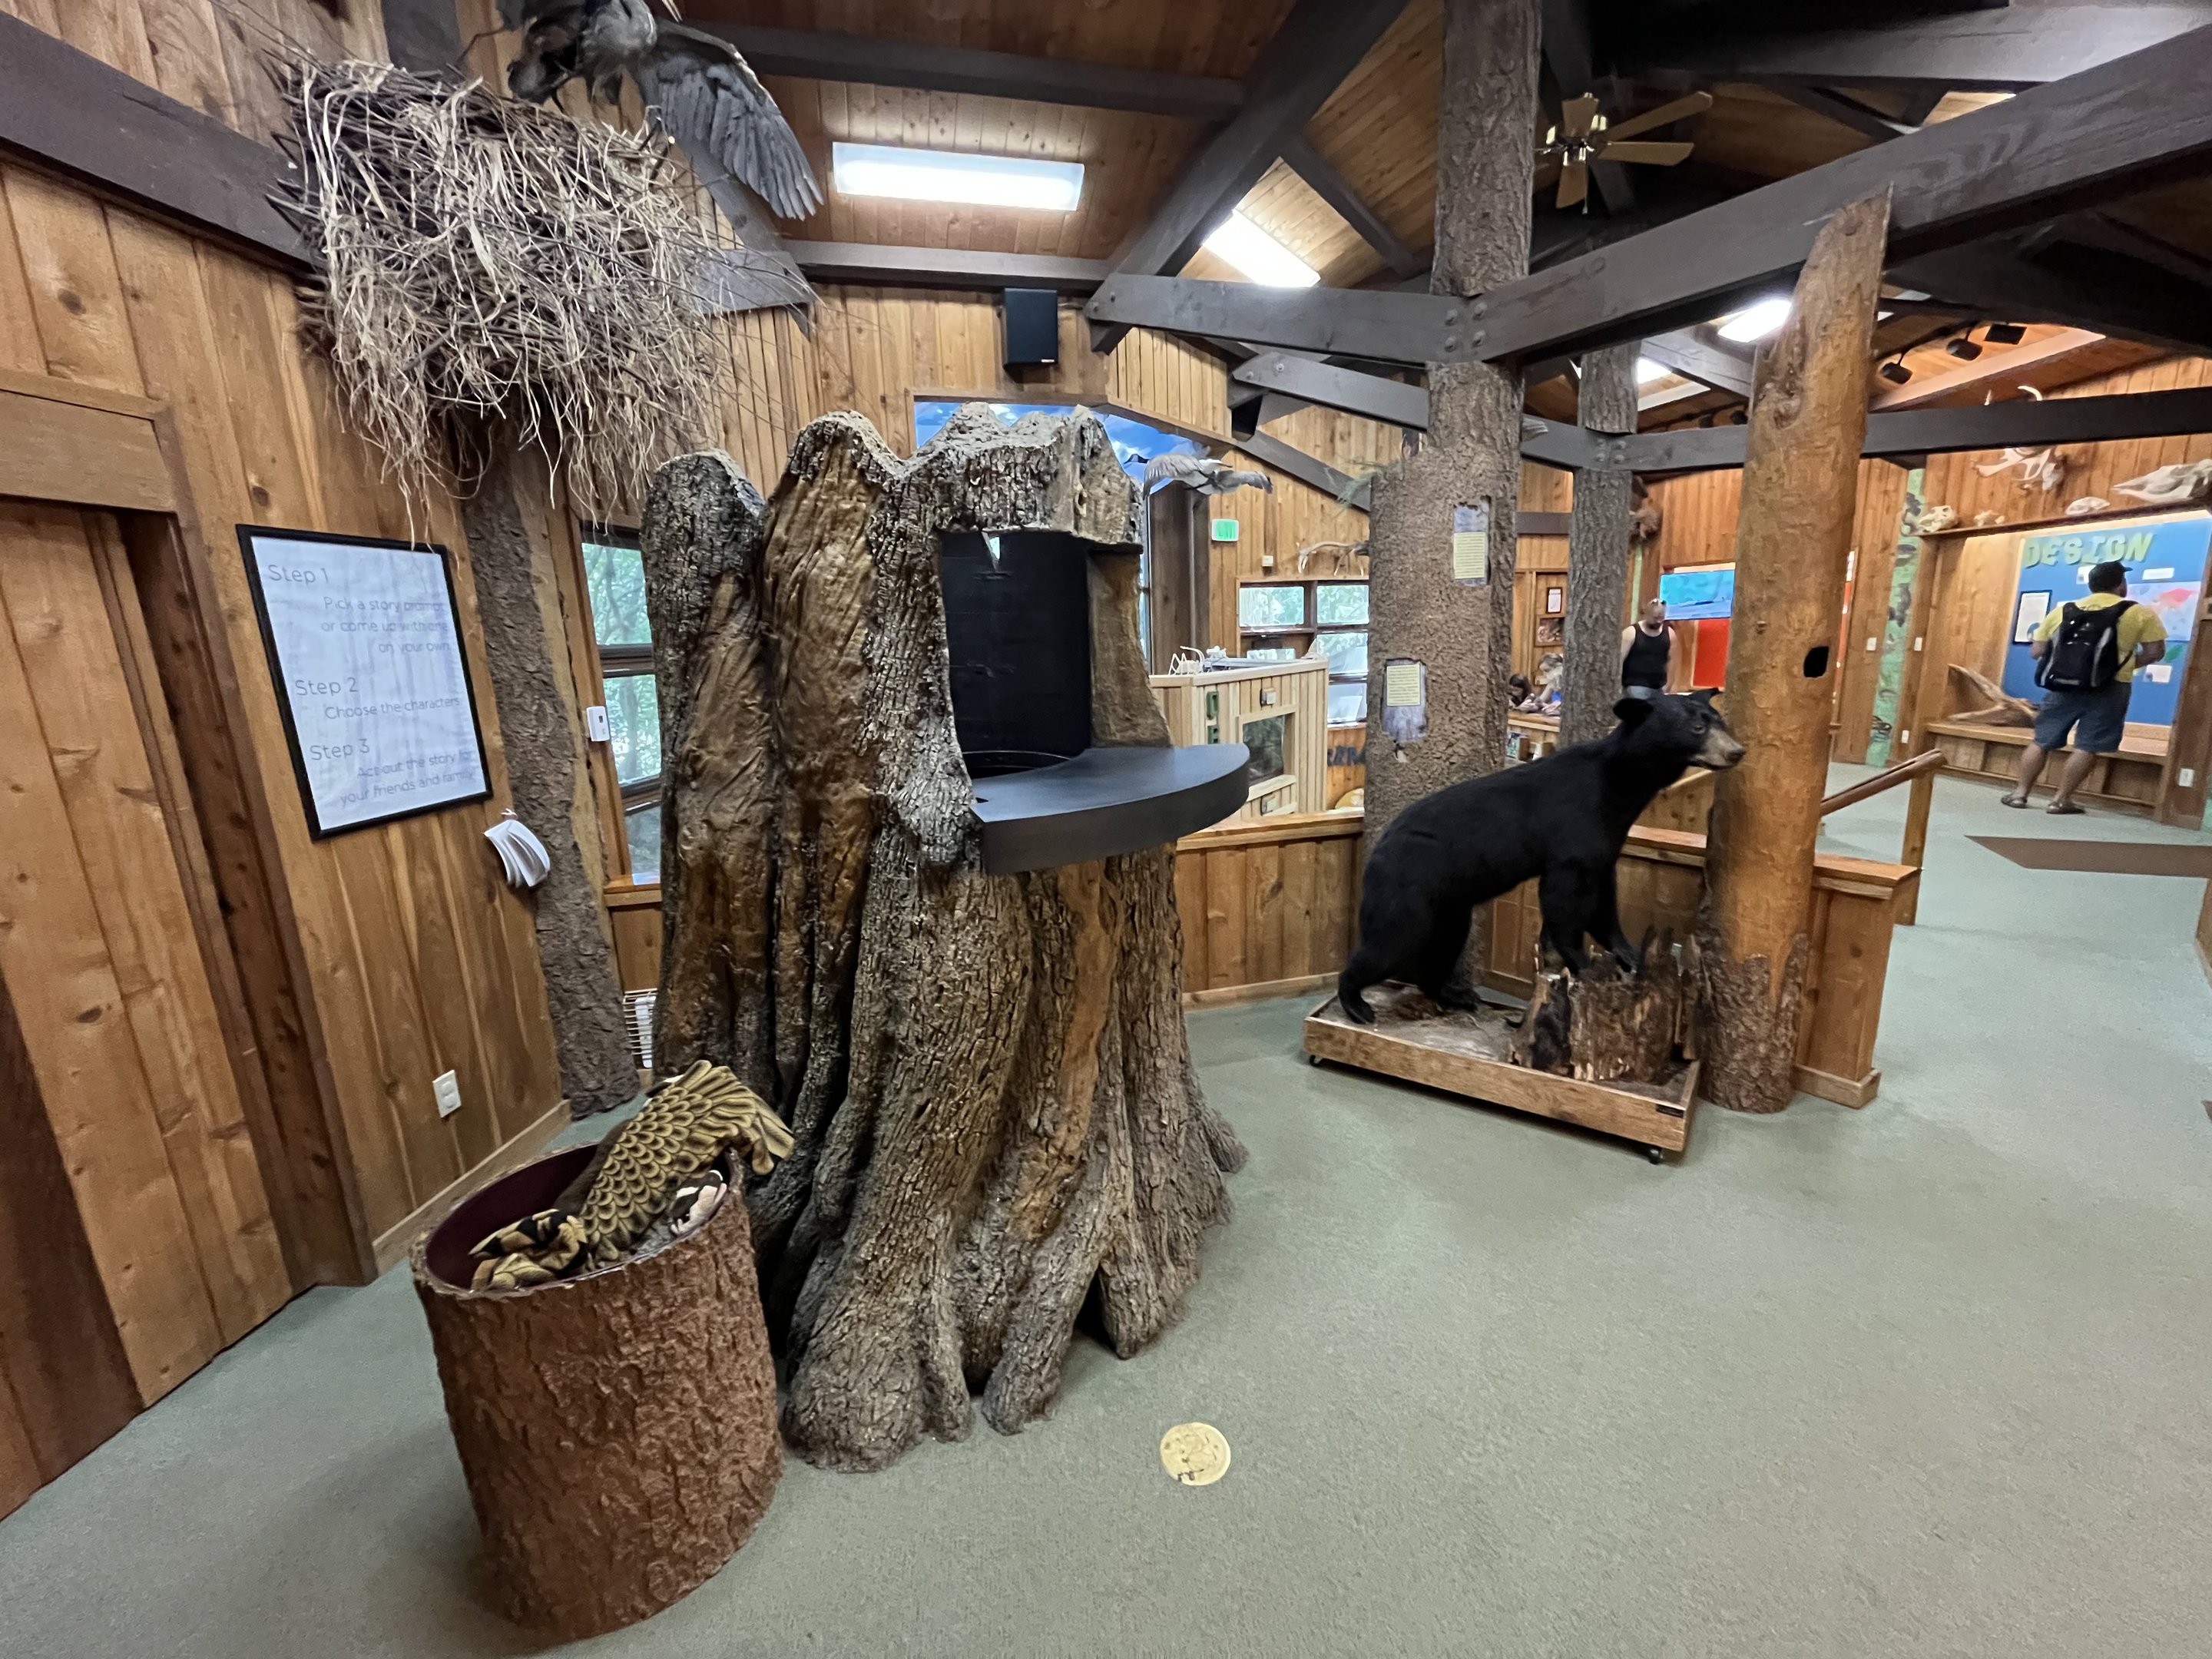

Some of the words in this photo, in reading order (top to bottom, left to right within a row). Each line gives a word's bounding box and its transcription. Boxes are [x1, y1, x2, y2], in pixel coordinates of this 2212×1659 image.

[2022, 533, 2154, 569] DESIGN
[268, 565, 316, 584] Step
[321, 568, 329, 583] 1
[357, 601, 366, 610] a
[369, 600, 400, 613] story
[295, 679, 341, 697] Step
[347, 677, 359, 692] 2
[325, 704, 377, 720] Choose
[381, 701, 402, 714] the
[310, 743, 353, 761] Step
[359, 738, 370, 754] 3
[340, 790, 369, 807] your
[419, 775, 441, 789] and
